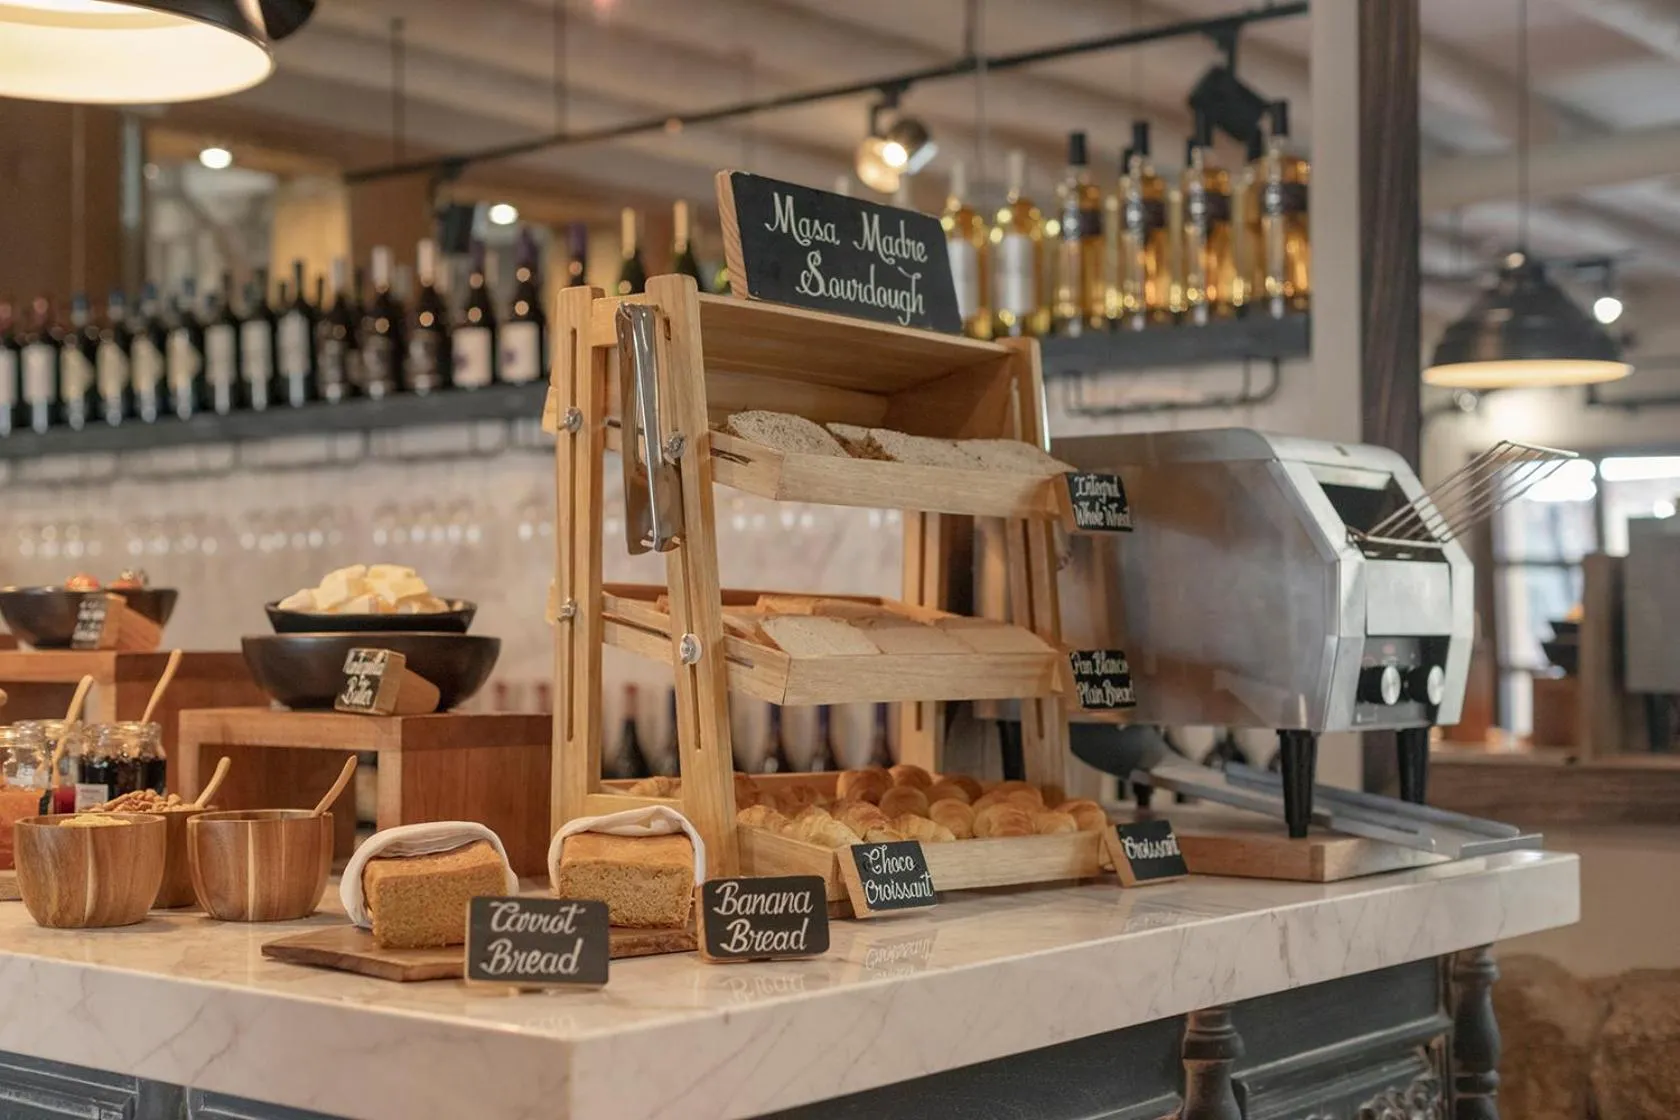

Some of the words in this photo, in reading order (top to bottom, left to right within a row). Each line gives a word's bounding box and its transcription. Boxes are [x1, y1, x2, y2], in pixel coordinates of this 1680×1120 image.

[765, 192, 841, 247] Masa
[853, 211, 929, 265] Madre
[795, 249, 926, 326] Sourdough
[862, 844, 917, 875] Choco
[712, 881, 814, 916] Banana
[863, 871, 934, 905] Croissant
[489, 901, 587, 935] Carrot
[720, 917, 808, 954] Bread
[478, 937, 585, 976] Bread
